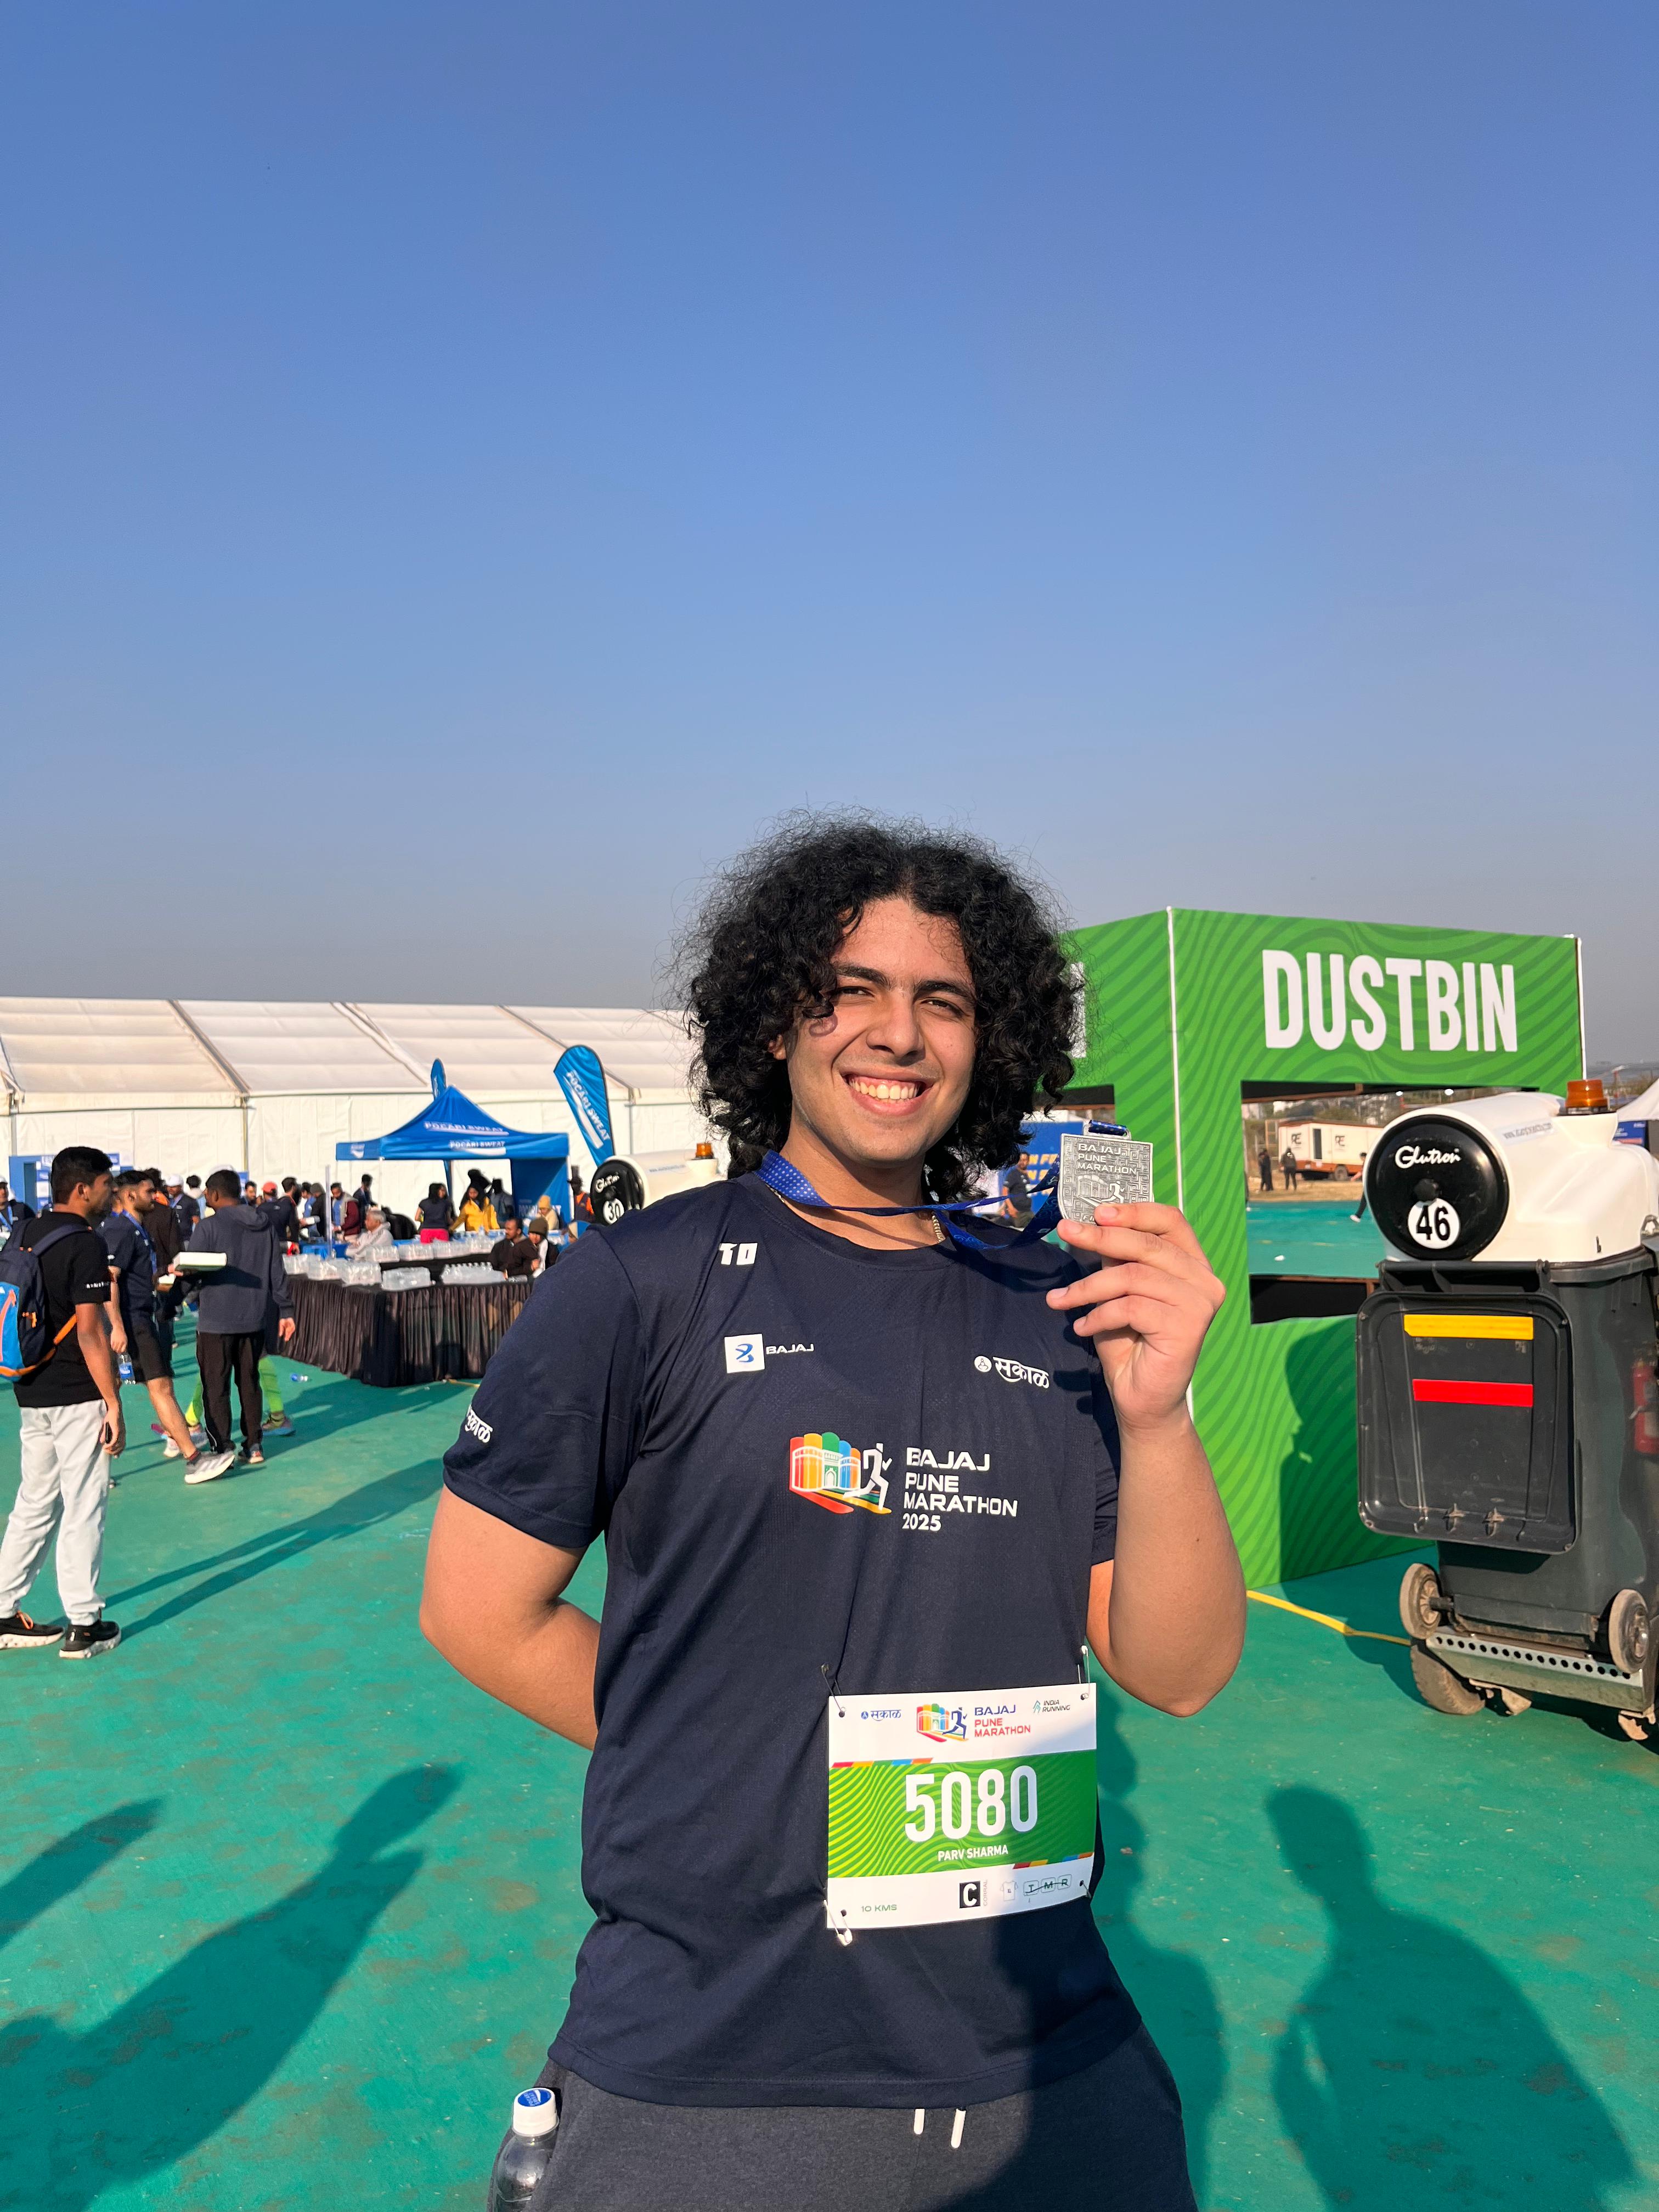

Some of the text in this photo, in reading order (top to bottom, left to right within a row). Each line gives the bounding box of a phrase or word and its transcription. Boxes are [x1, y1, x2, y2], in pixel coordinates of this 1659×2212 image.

[1262, 949, 1517, 1052] DUSTBIN
[1078, 1143, 1121, 1155] BAJAJ
[1078, 1153, 1107, 1163] PUNE
[1077, 1163, 1137, 1175] MARATHON
[608, 1203, 622, 1221] 30
[1416, 1205, 1451, 1241] 46
[766, 1344, 814, 1355] BAJAJ
[992, 1356, 1049, 1389] सकाळ
[906, 1447, 990, 1471] BAJAJ
[905, 1472, 960, 1493] PUNE
[904, 1492, 1018, 1517] MARATHON
[902, 1513, 941, 1531] 2025
[870, 1709, 901, 1721] सकाळ
[974, 1705, 1016, 1716] BAJAJ
[974, 1718, 1003, 1728] PUNE
[974, 1725, 1031, 1737] MARATHON
[905, 1765, 1037, 1842] 5080
[938, 1845, 1008, 1861] PARV SHARMA
[963, 1883, 978, 1907] C
